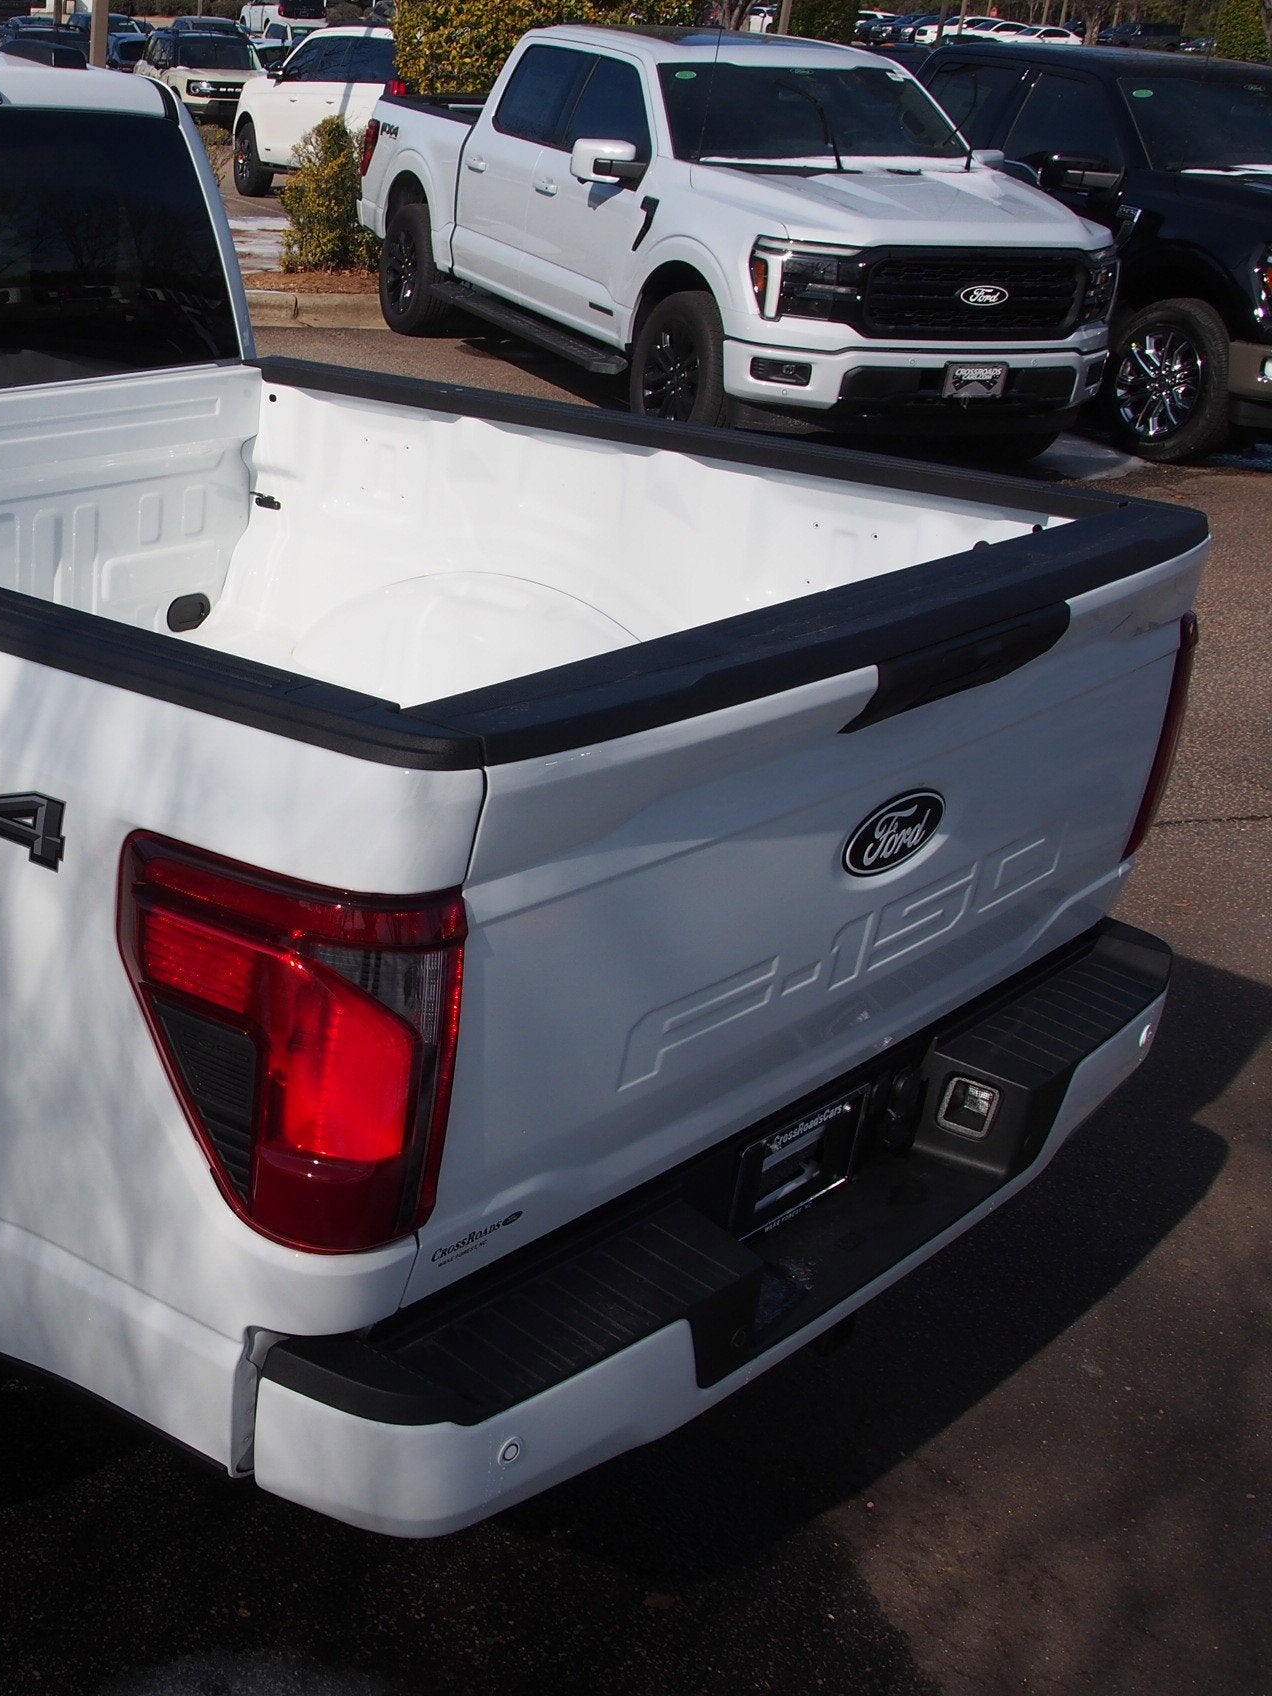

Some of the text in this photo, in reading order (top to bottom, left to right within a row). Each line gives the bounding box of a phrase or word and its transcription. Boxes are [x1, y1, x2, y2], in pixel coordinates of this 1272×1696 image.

[969, 288, 1000, 303] Ford
[955, 368, 1003, 376] CROSSROADS
[862, 803, 932, 867] Ford
[617, 822, 1069, 1093] F-150
[773, 1103, 843, 1146] CrossRoadsCars
